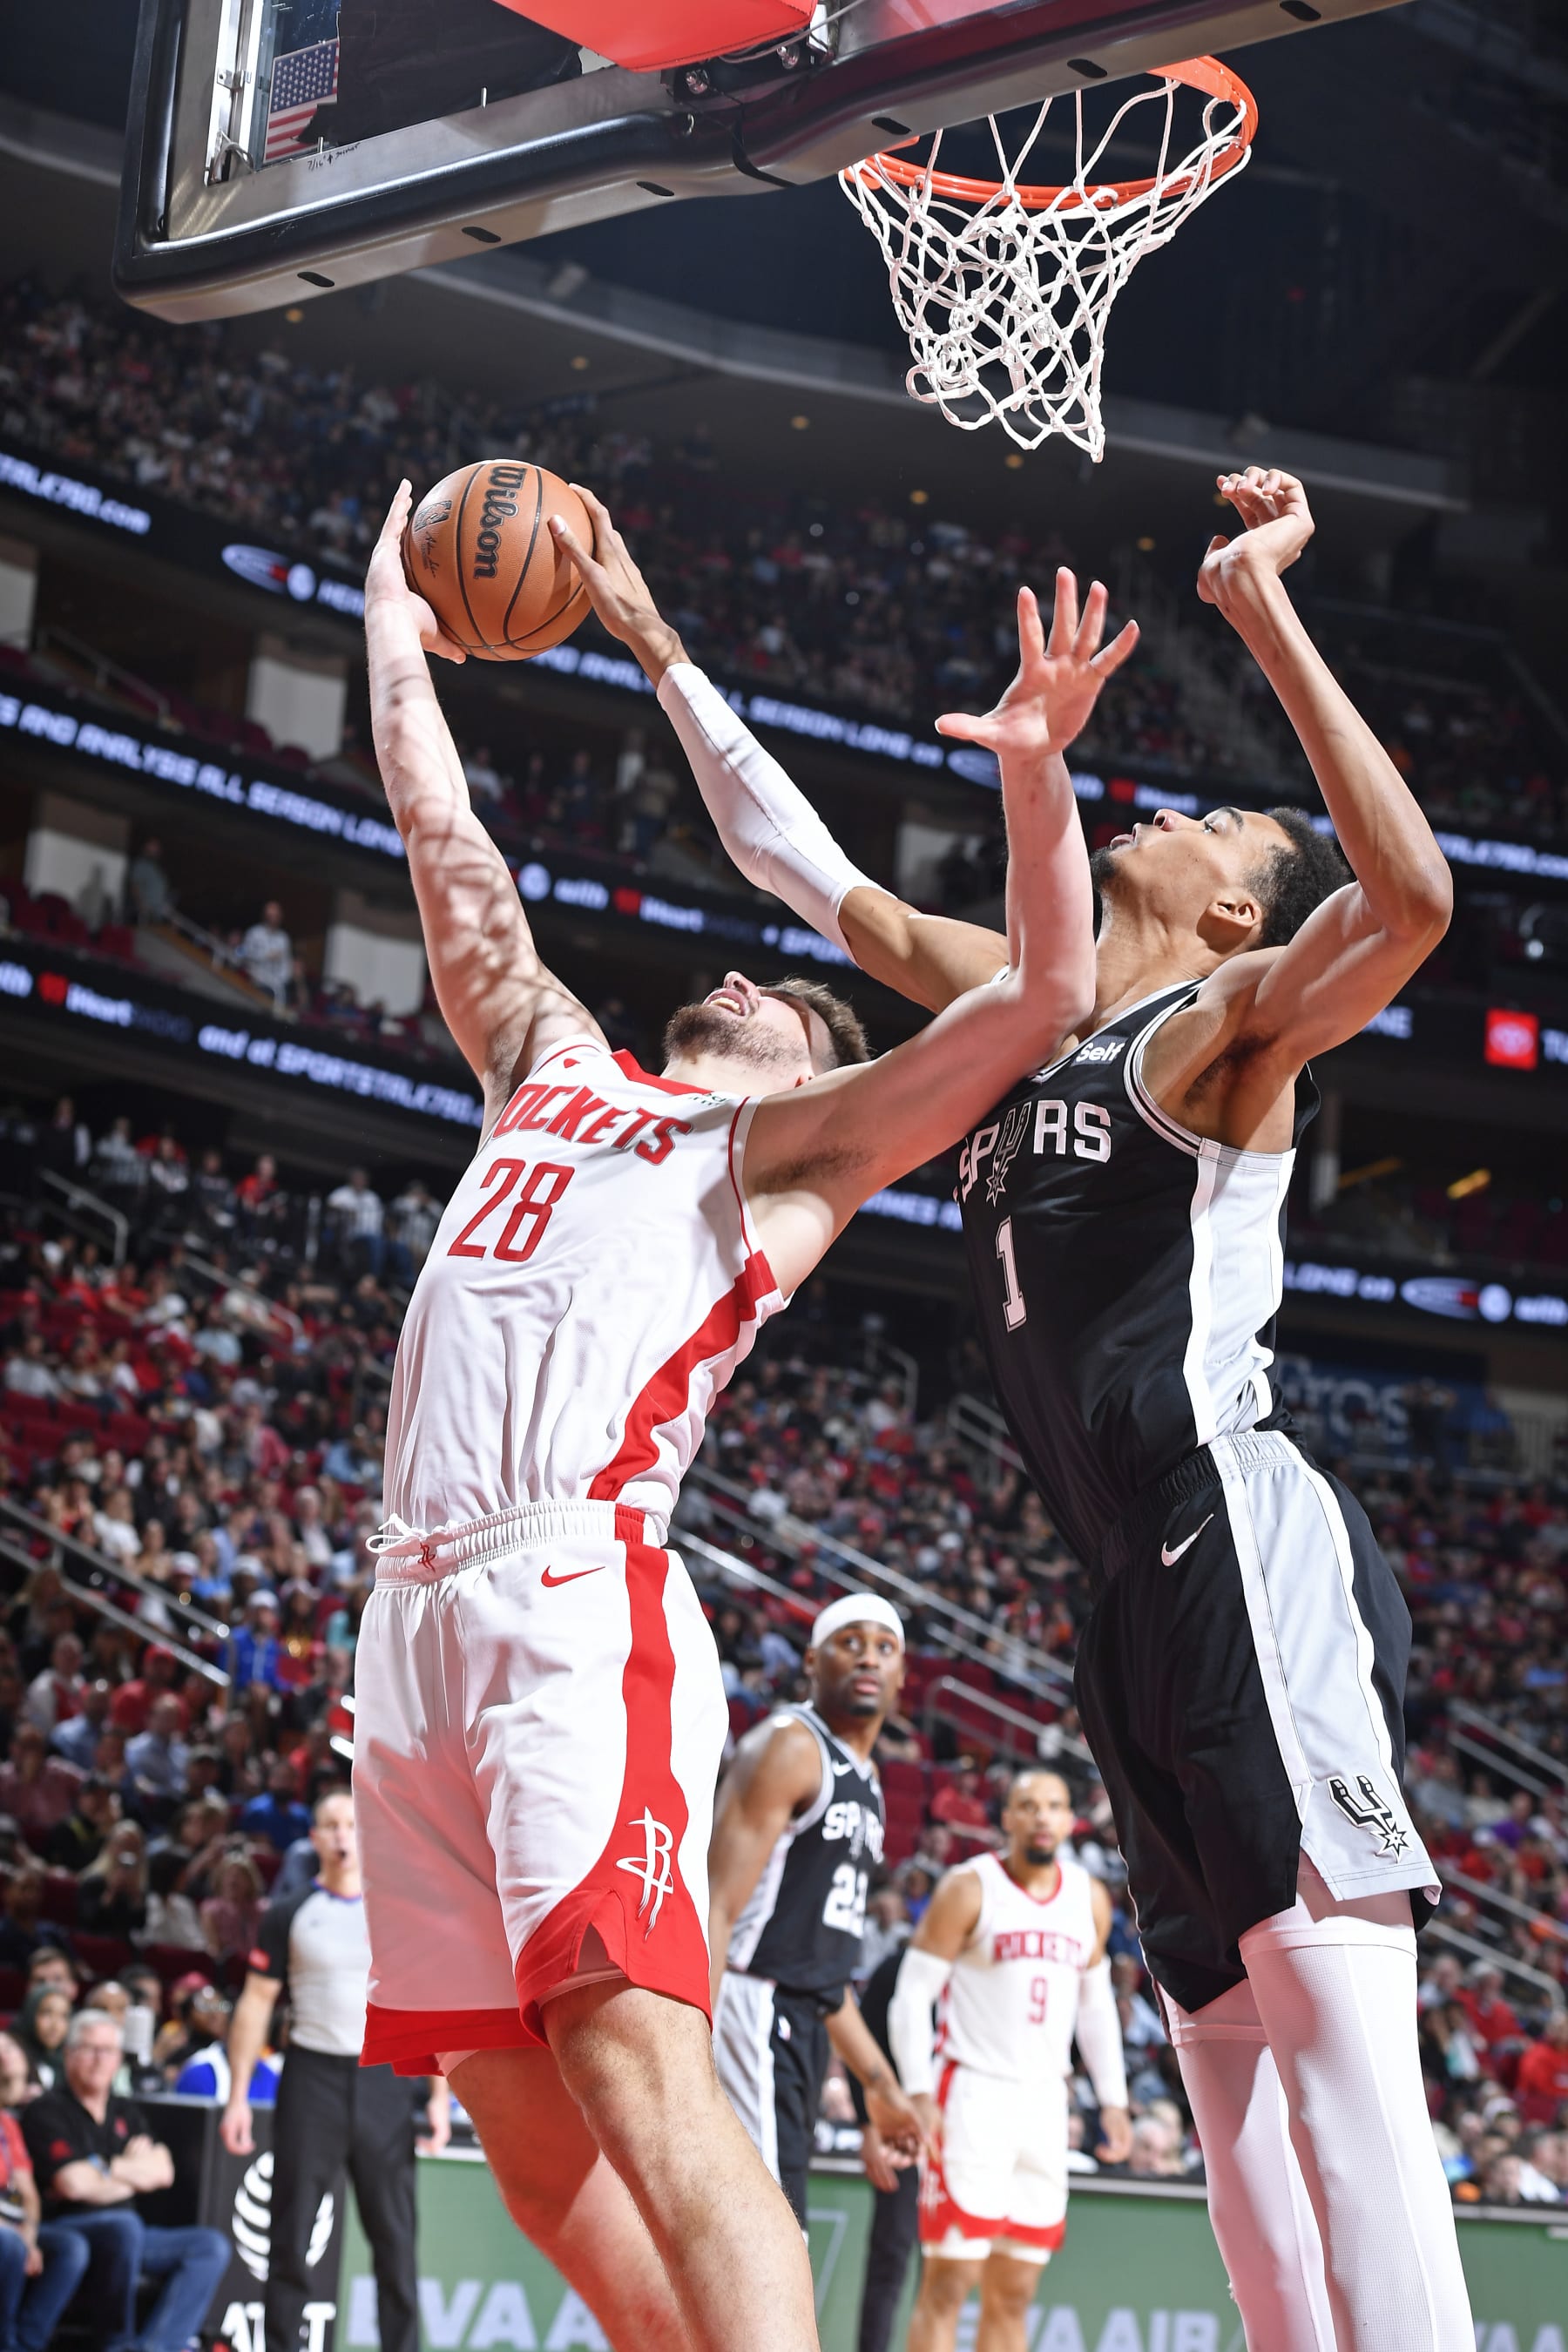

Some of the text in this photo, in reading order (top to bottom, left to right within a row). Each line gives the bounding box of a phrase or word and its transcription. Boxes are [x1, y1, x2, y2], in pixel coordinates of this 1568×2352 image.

[474, 465, 527, 580] Wilson
[1076, 1042, 1125, 1063] Self
[490, 1083, 693, 1166] OCKETS
[447, 1158, 576, 1262] 28
[995, 1216, 1028, 1332] 1
[1029, 1976, 1047, 2024] 9
